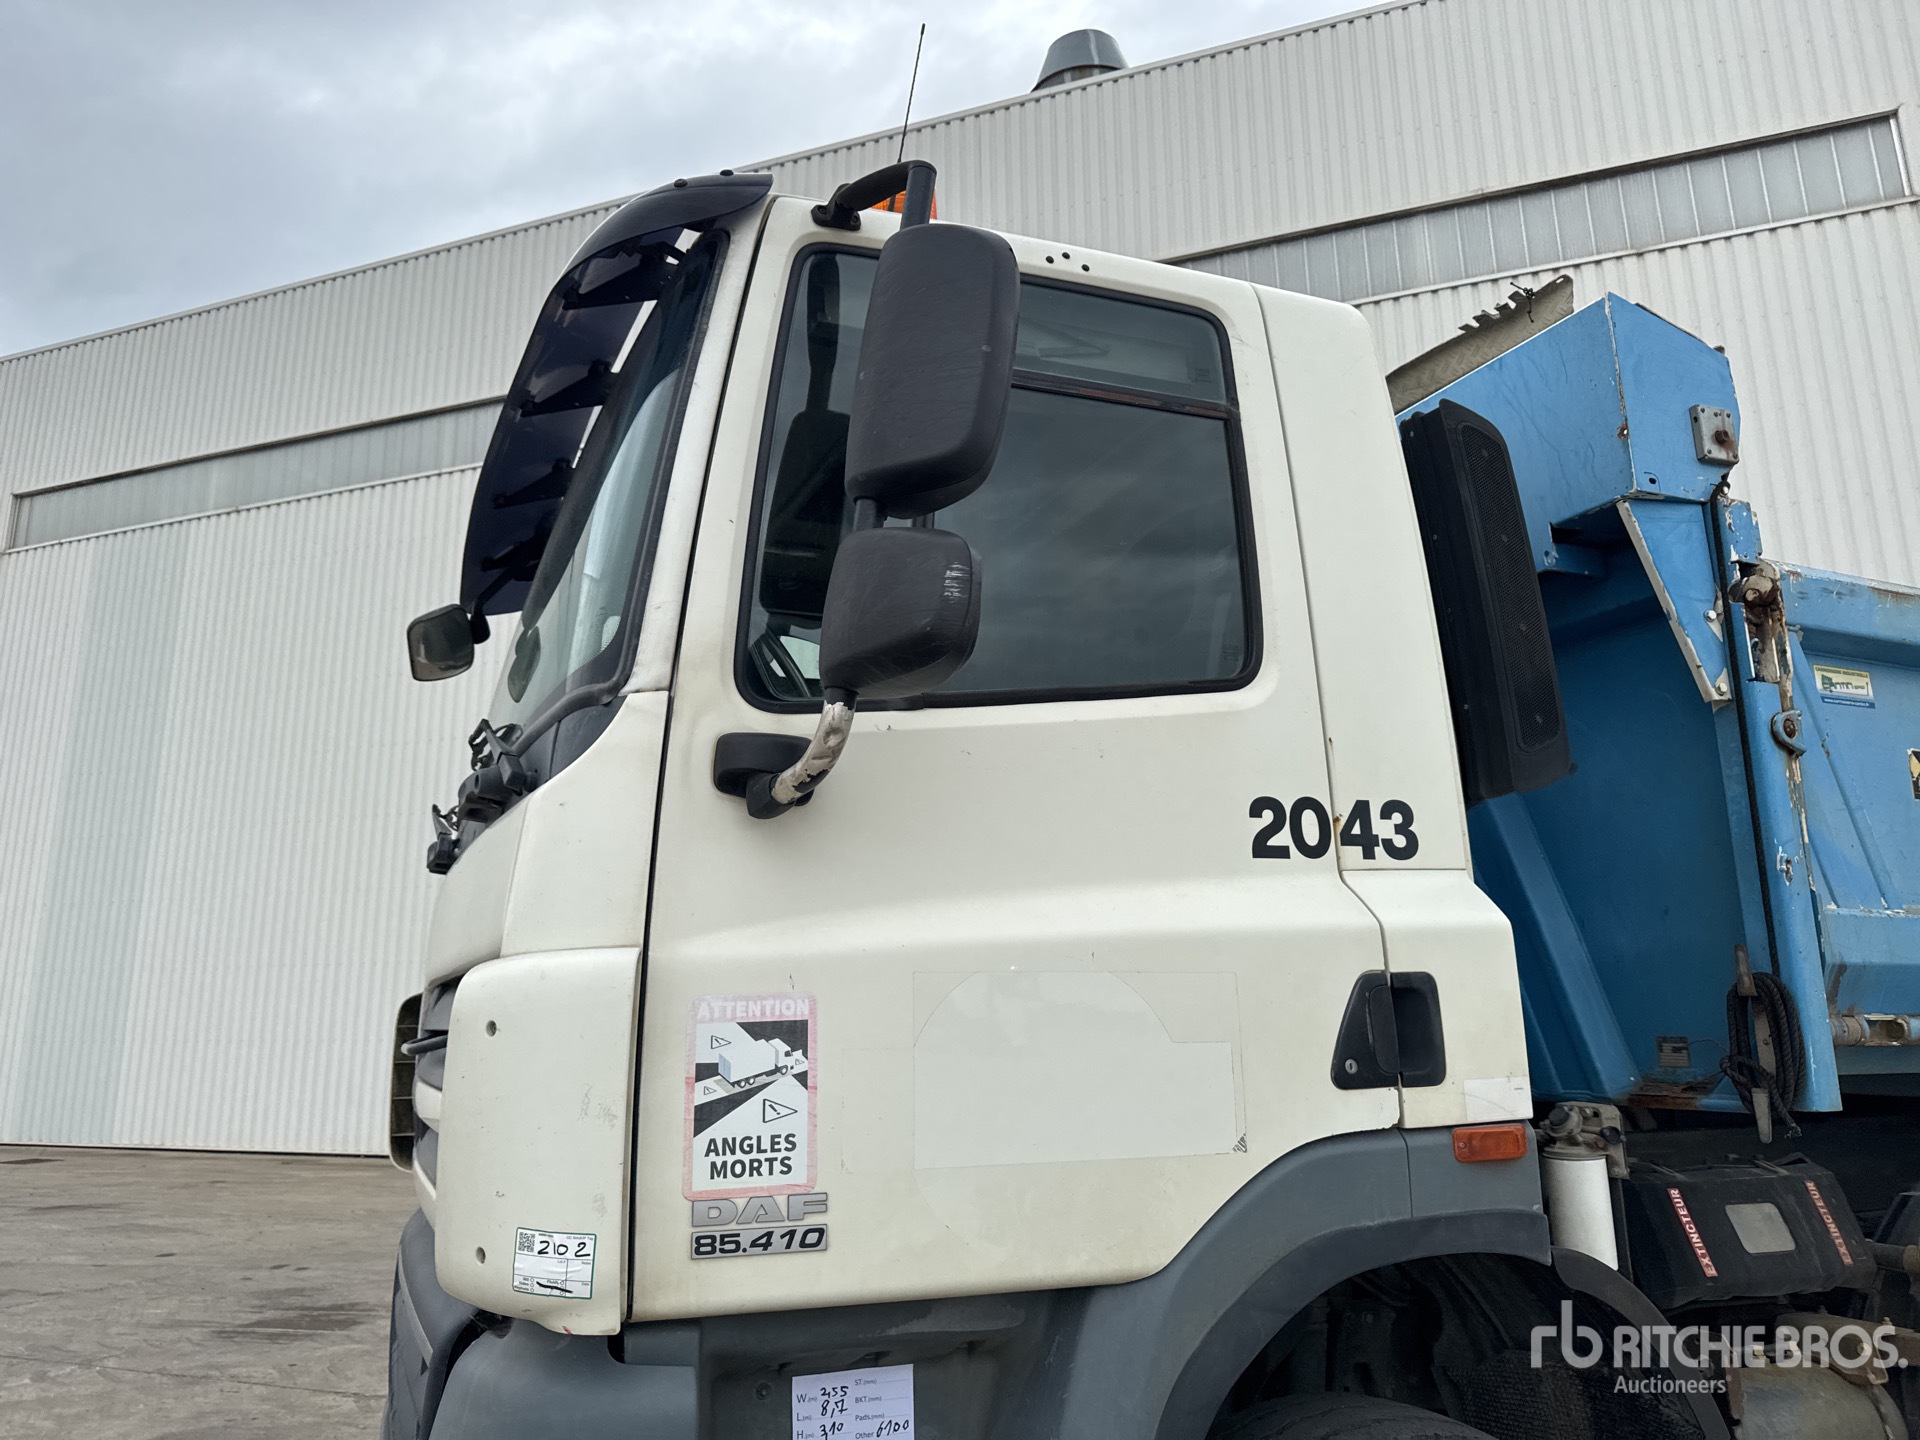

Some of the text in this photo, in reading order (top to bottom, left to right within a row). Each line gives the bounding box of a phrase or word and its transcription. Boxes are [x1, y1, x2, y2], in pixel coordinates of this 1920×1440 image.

[1249, 796, 1419, 860] 2043
[697, 999, 810, 1019] ATTENTION
[704, 1133, 797, 1157] ANGLES
[709, 1156, 793, 1180] MORTS
[692, 1193, 827, 1227] DAF
[1805, 1180, 1852, 1264] EXTINCTEUR
[693, 1227, 826, 1256] 85.410
[1668, 1188, 1717, 1275] EXTINCTEUR
